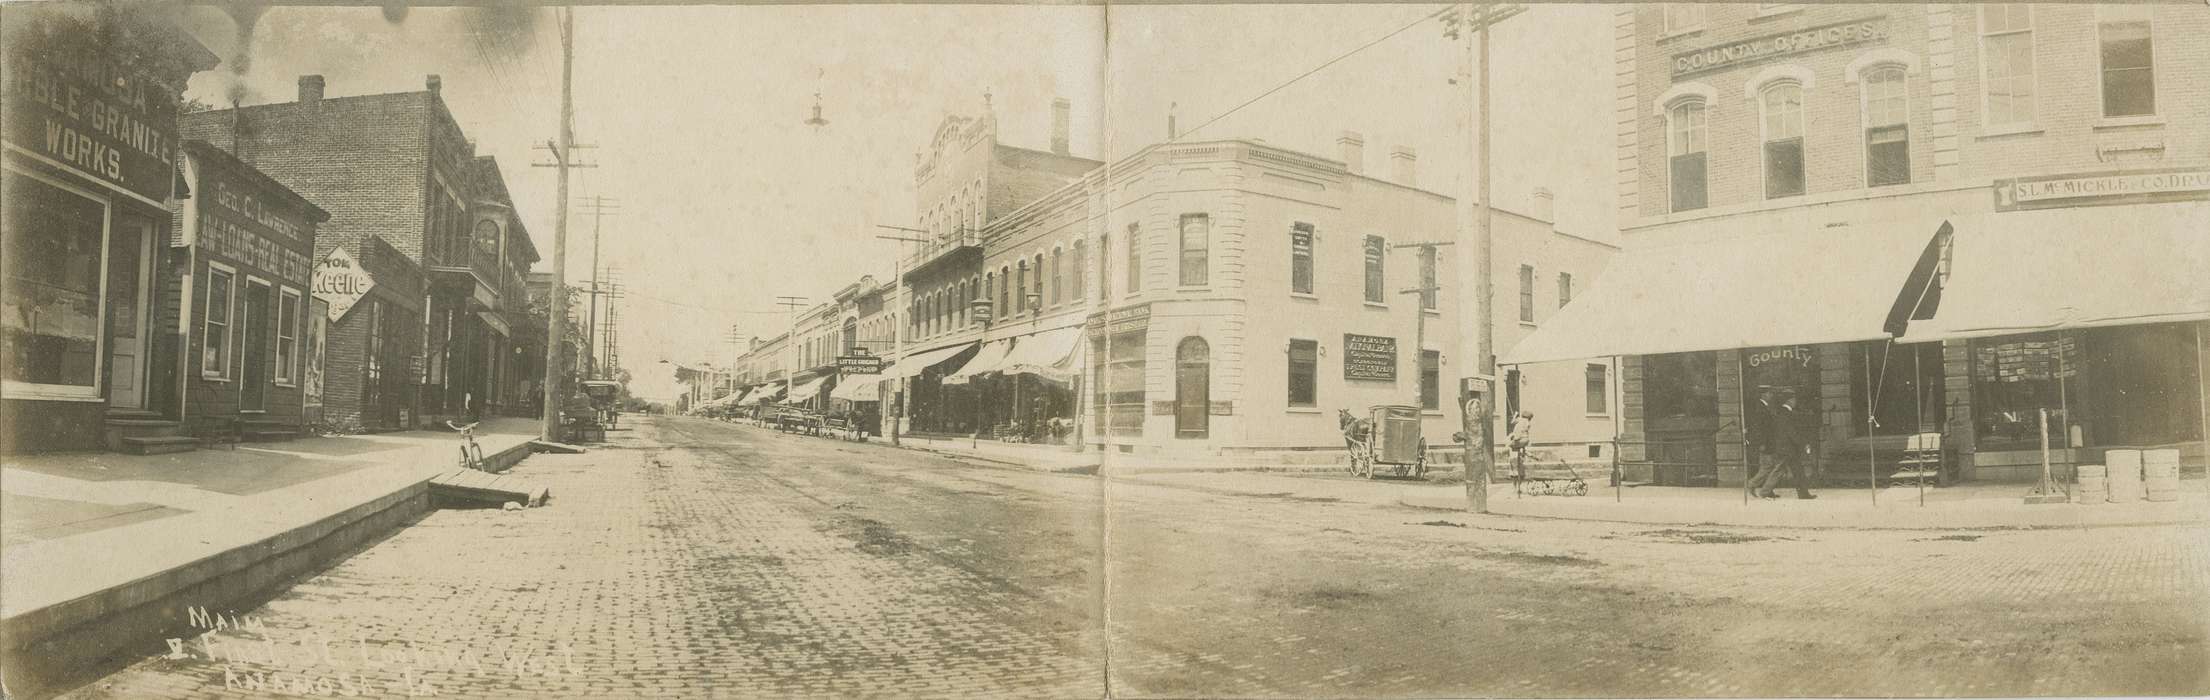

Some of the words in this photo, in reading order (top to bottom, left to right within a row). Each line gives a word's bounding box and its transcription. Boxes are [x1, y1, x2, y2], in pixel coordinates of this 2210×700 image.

[1676, 43, 1758, 73] COUNTY
[46, 119, 124, 182] WORKS.
[92, 98, 173, 168] GRANITE
[312, 271, 370, 295] Keene
